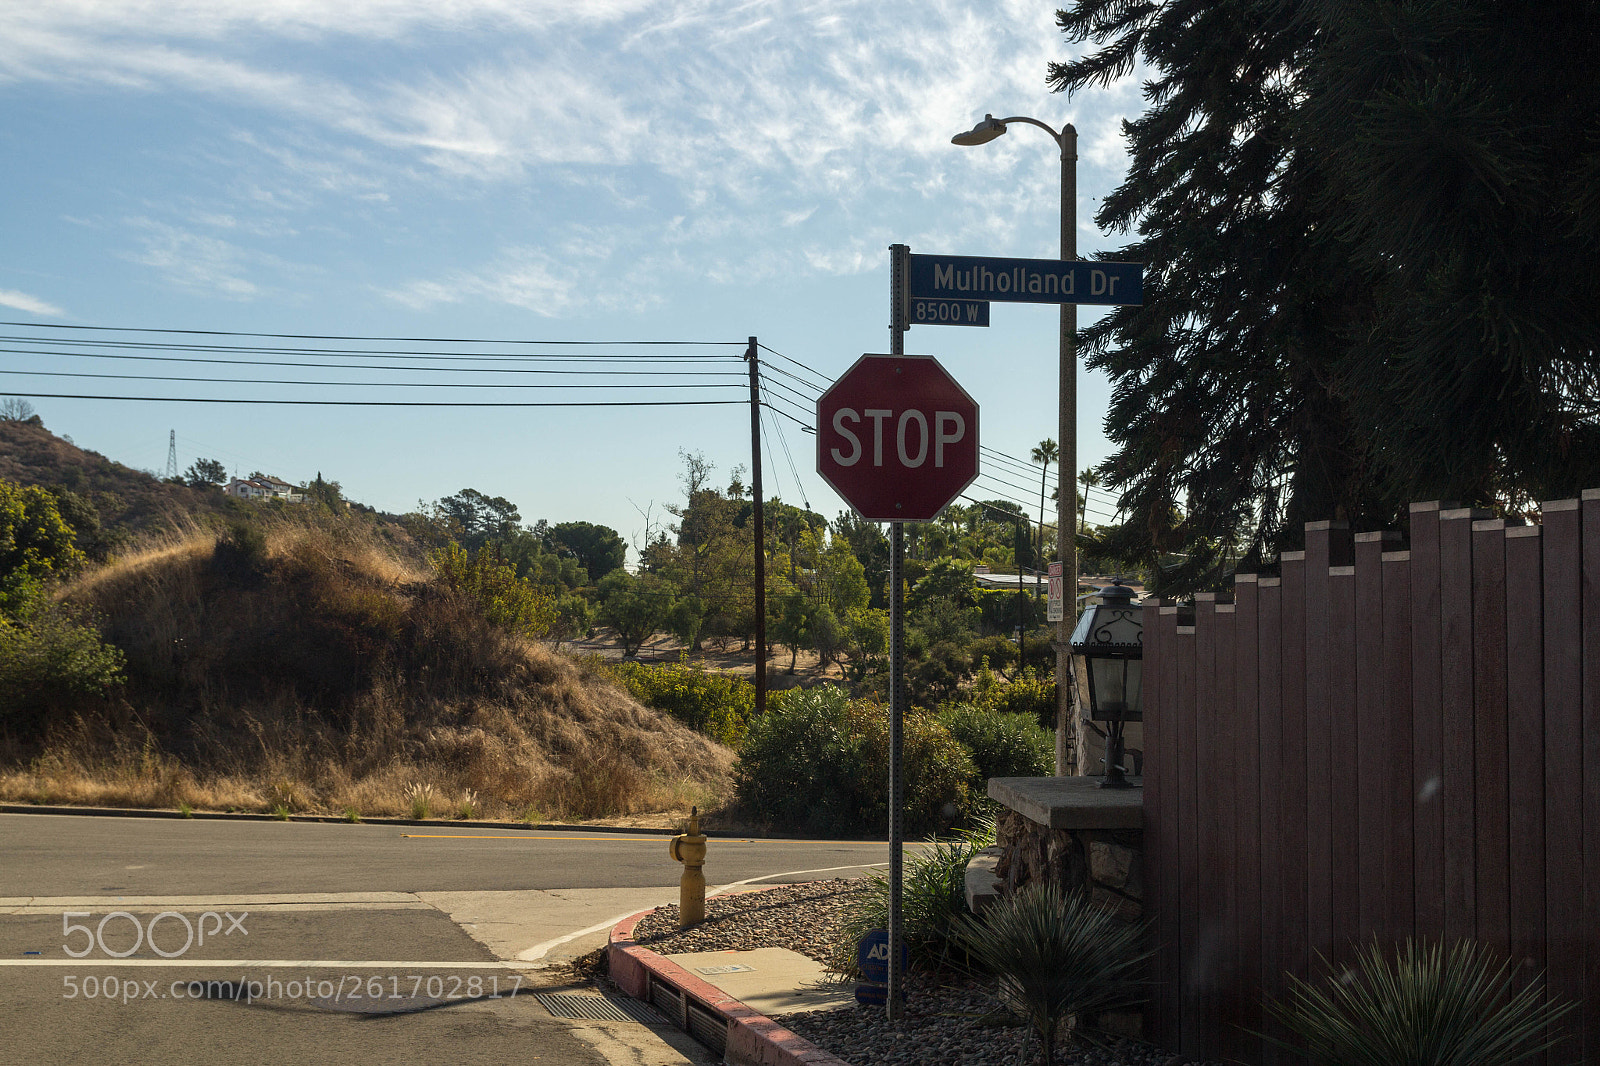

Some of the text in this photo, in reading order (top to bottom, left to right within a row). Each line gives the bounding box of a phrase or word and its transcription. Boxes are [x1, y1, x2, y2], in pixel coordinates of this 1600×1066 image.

[934, 263, 1120, 296] Mulholland Dr
[916, 302, 979, 322] 8500 W
[830, 407, 966, 469] STOP
[866, 943, 889, 960] AD
